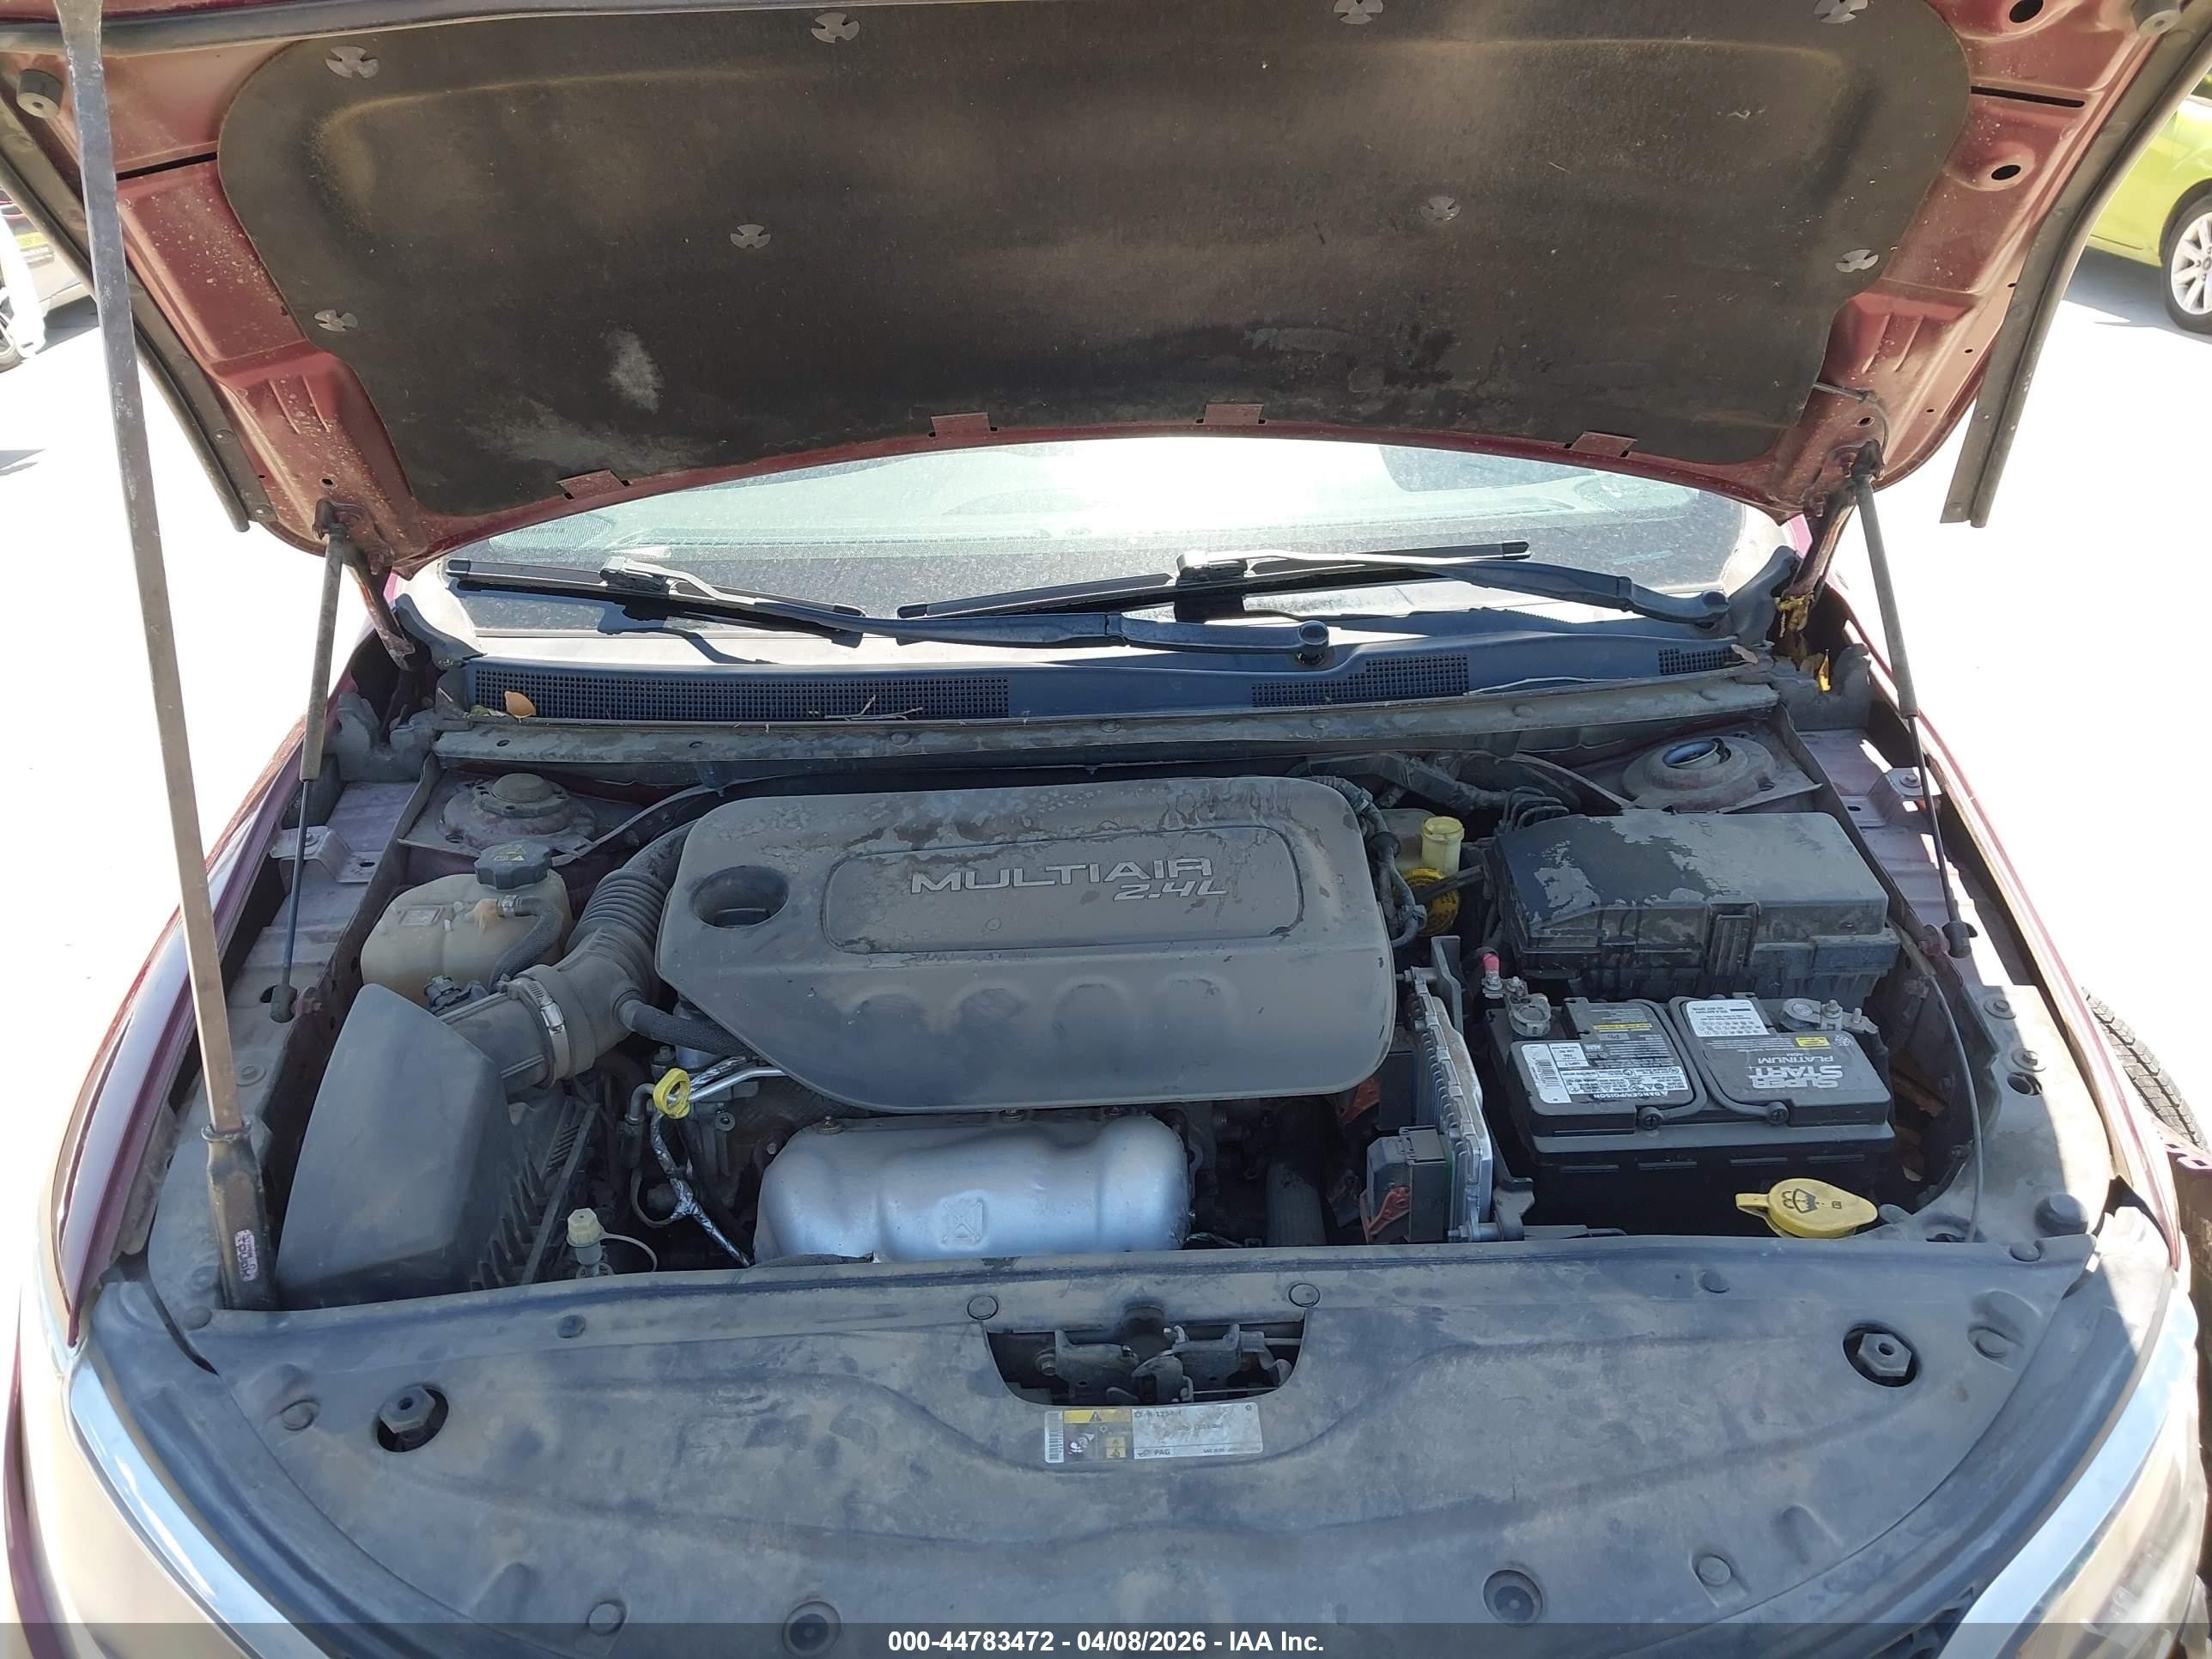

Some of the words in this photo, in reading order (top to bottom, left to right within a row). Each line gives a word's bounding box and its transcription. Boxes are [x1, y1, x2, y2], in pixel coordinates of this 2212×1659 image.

[910, 857, 1214, 894] MULTIAIR
[1113, 879, 1228, 902] 2.4L
[1757, 1055, 1834, 1064] PLATINUM
[1748, 1065, 1843, 1079] START
[1752, 1077, 1839, 1089] SUPER
